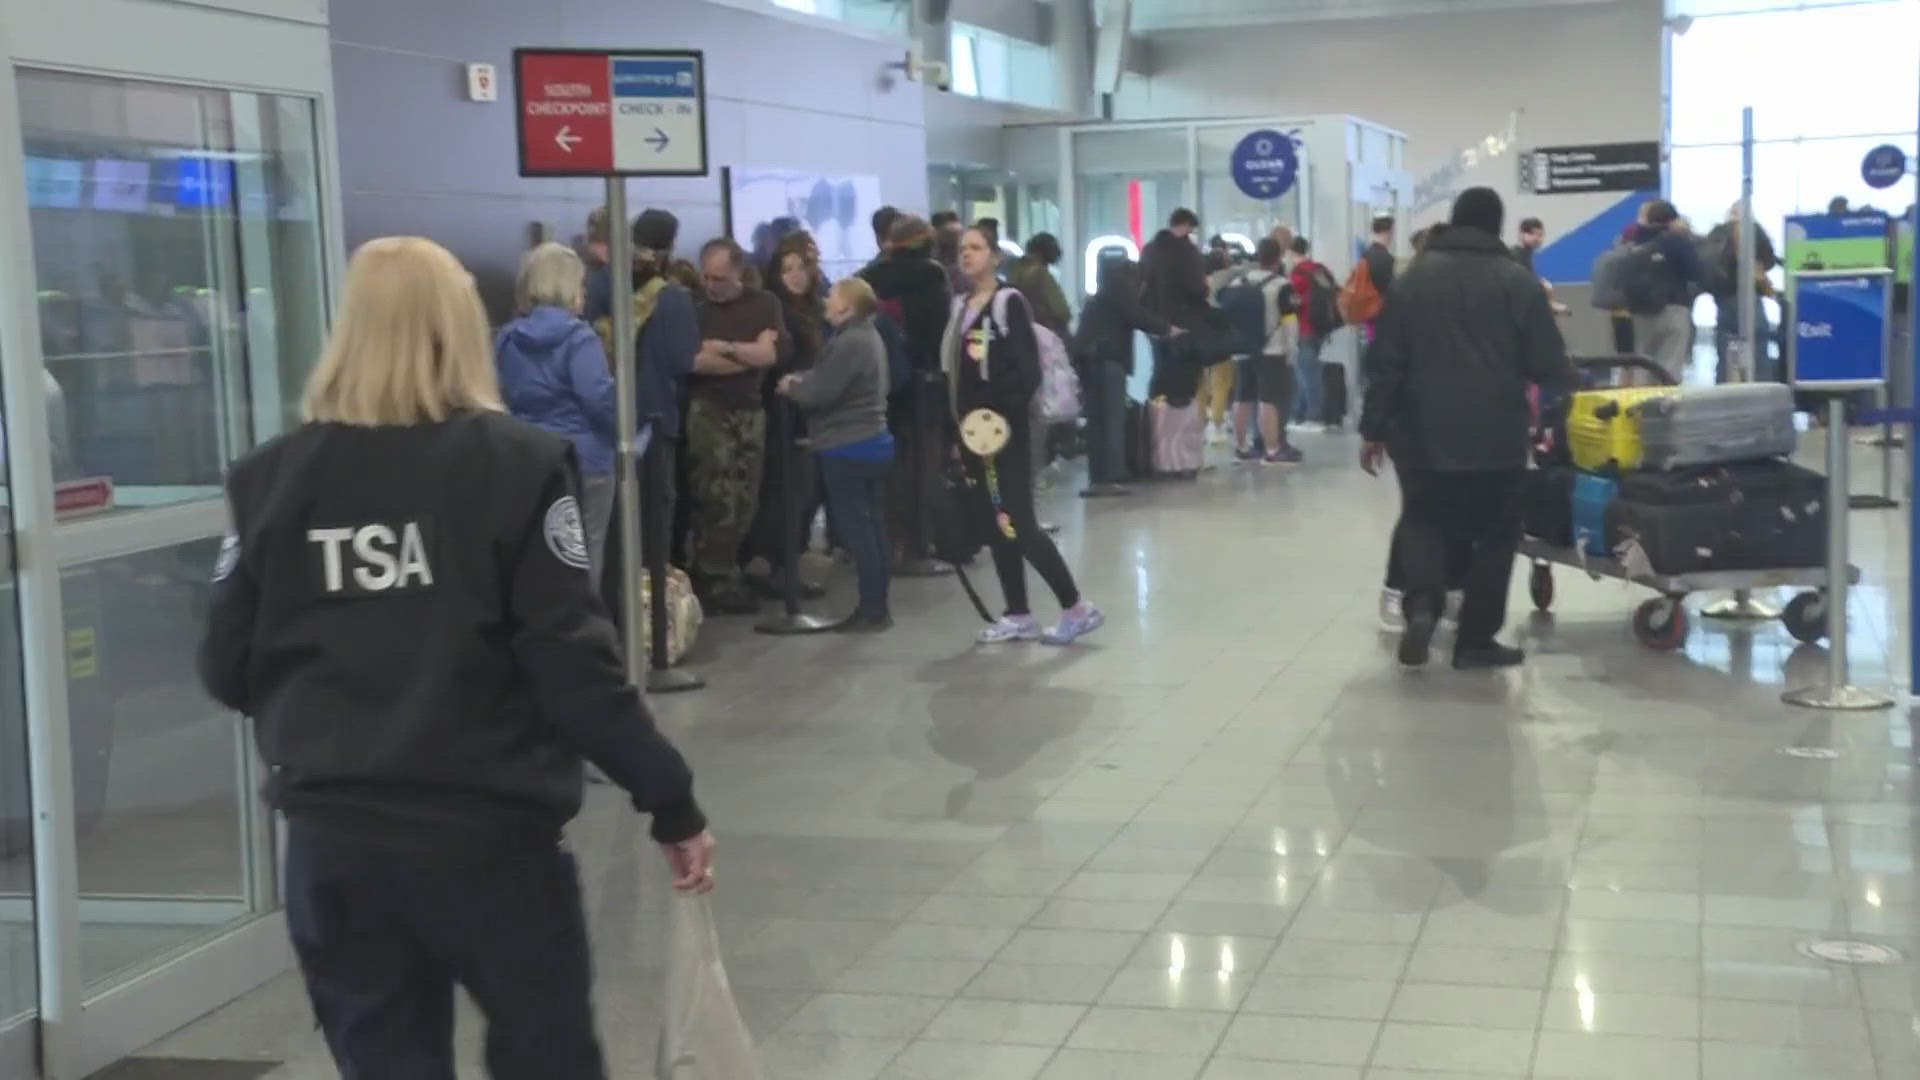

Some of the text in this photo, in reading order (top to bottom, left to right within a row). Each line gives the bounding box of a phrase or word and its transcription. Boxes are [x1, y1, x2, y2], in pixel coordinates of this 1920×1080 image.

[544, 83, 592, 96] SOUTH
[527, 101, 608, 115] CHECKPOINT
[619, 103, 664, 115] CHECK
[1799, 321, 1832, 338] Exit
[307, 522, 434, 592] TSA
